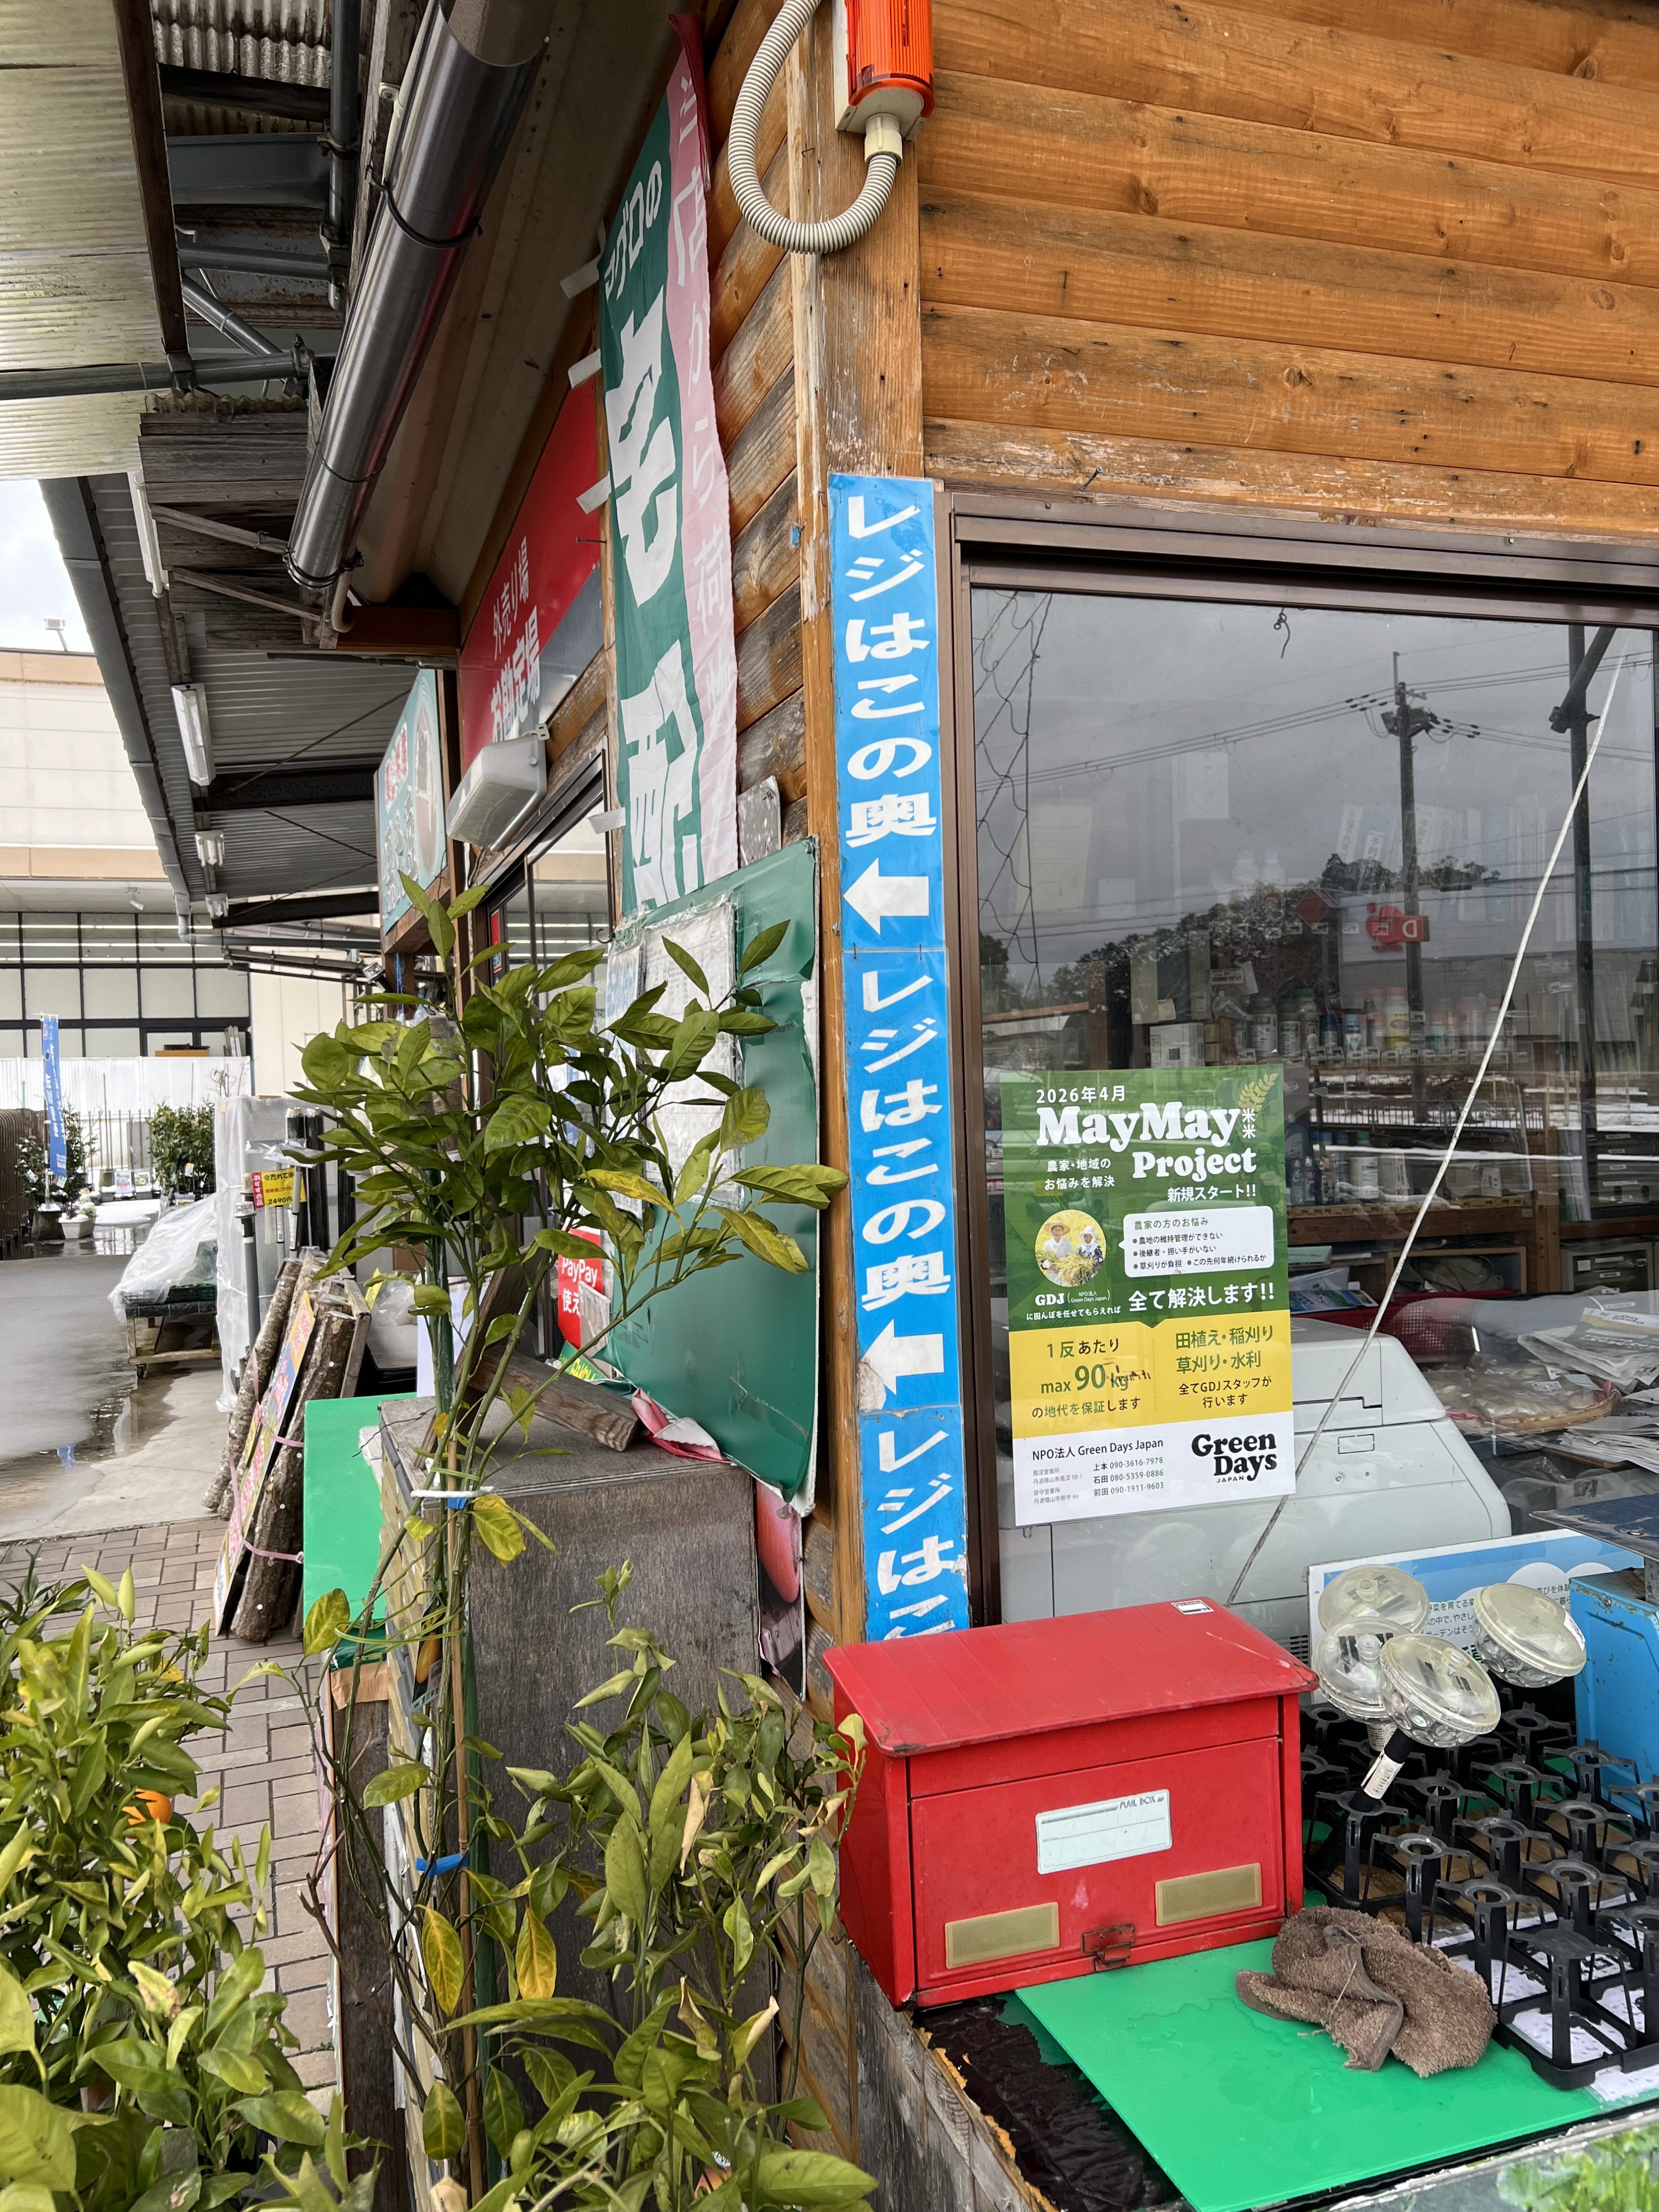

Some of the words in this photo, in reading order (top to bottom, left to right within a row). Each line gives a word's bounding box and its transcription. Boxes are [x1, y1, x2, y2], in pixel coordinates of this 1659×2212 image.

[845, 495, 936, 848] レジはこの奥
[1036, 1085, 1126, 1104] 2026年4月
[1036, 1101, 1240, 1152] MayMay
[1241, 1108, 1256, 1139] 米米
[860, 971, 951, 1311] レジはこの奥
[1047, 1158, 1111, 1172] 農家・地域の
[1132, 1147, 1256, 1182] Project
[1044, 1175, 1115, 1191] お悩みを解決
[1167, 1184, 1256, 1203] 新規スタート!!
[1134, 1217, 1209, 1230] 農家の方のお悩み
[1139, 1233, 1223, 1244] 農地の維持管理ができない
[1139, 1245, 1217, 1257] 後継者・担い手がいない
[1193, 1255, 1266, 1266] この先何年続けられるか
[562, 1258, 598, 1287] PayPay
[1140, 1260, 1182, 1270] 草刈りが負担
[1035, 1293, 1065, 1306] GDJ
[1128, 1282, 1274, 1312] 全て解決します!!
[1026, 1306, 1121, 1321] に田んぼを任せてもらえれば
[1176, 1325, 1274, 1350] 田植え・稲刈り
[1176, 1350, 1261, 1374] 草刈り・水利
[1040, 1380, 1071, 1394] max
[1074, 1364, 1106, 1391] 90
[1110, 1373, 1129, 1391] kg
[1178, 1375, 1272, 1396] 全てGDJスタッフが
[1032, 1397, 1141, 1418] の地代を保証します
[1202, 1394, 1248, 1408] 行います
[1032, 1447, 1075, 1460] NPO法人
[1078, 1445, 1107, 1455] Green
[1110, 1442, 1133, 1454] Days
[1135, 1439, 1164, 1451] Japan
[1191, 1433, 1277, 1458] Green
[1093, 1462, 1108, 1471] 上本
[1109, 1457, 1164, 1469] 090-3616-7978
[1213, 1453, 1277, 1481] Days
[1093, 1475, 1109, 1484] 石田
[1110, 1469, 1164, 1482] 080-5359-0886
[1093, 1488, 1109, 1497] 前田
[1110, 1482, 1164, 1495] 090-1911-9603
[1430, 1598, 1474, 1612] 菜を育てる楽
[1427, 1613, 1473, 1625] の中で、やさし
[1120, 1800, 1137, 1809] MAIL
[1140, 1795, 1156, 1806] BOX
